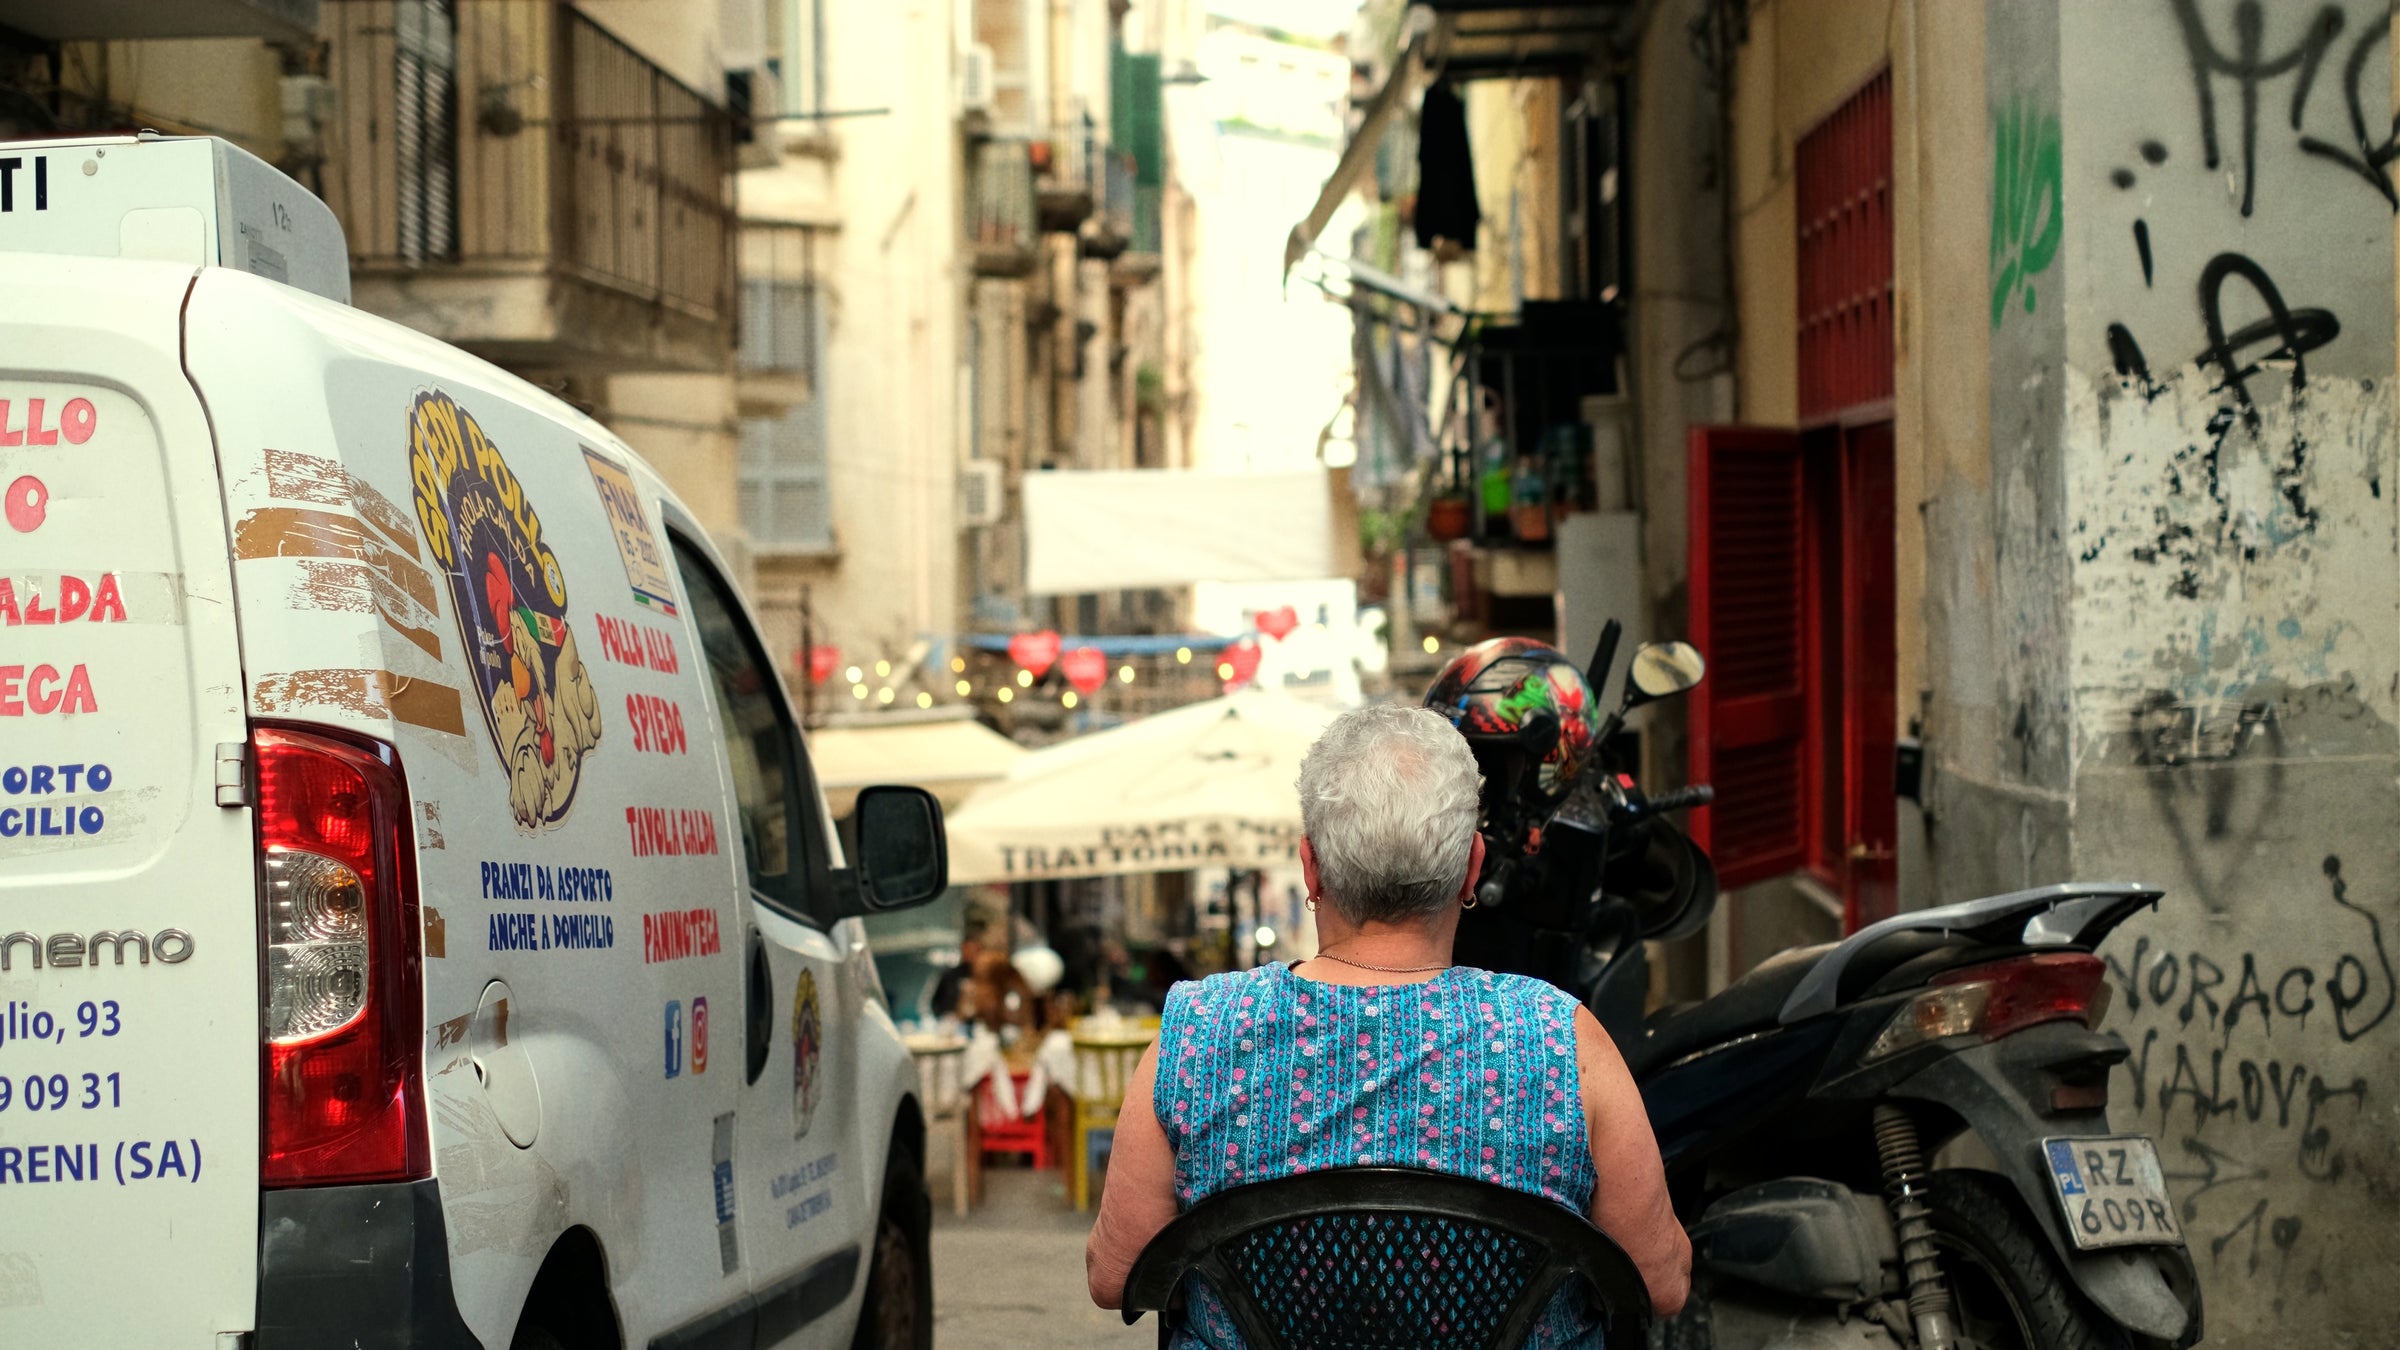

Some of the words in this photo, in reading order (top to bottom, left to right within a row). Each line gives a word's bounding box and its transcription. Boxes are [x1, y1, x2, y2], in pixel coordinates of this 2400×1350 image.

[595, 612, 645, 668] POLLO
[643, 626, 679, 675] ALLA
[626, 693, 687, 756] SPIEDO
[626, 806, 682, 857] TAVOLA
[681, 808, 718, 856] CALDA
[1000, 838, 1228, 874] TRATTORIA
[481, 861, 533, 900] PRANZI
[536, 864, 555, 900] DA
[558, 866, 613, 902] ASPORTO
[0, 927, 195, 971] nemo
[488, 912, 538, 951] ANCHE
[541, 914, 551, 950] A
[553, 913, 614, 949] DOMICILIO
[643, 908, 721, 964] PANINOTECA
[0, 1000, 65, 1048] lio,
[77, 1000, 121, 1038] 93
[24, 1073, 69, 1111] 09
[81, 1072, 121, 1109] 31
[115, 1138, 201, 1185] (SA)
[2059, 1173, 2083, 1190] PL
[2085, 1149, 2134, 1186] RZ
[2080, 1197, 2173, 1235] 609R
